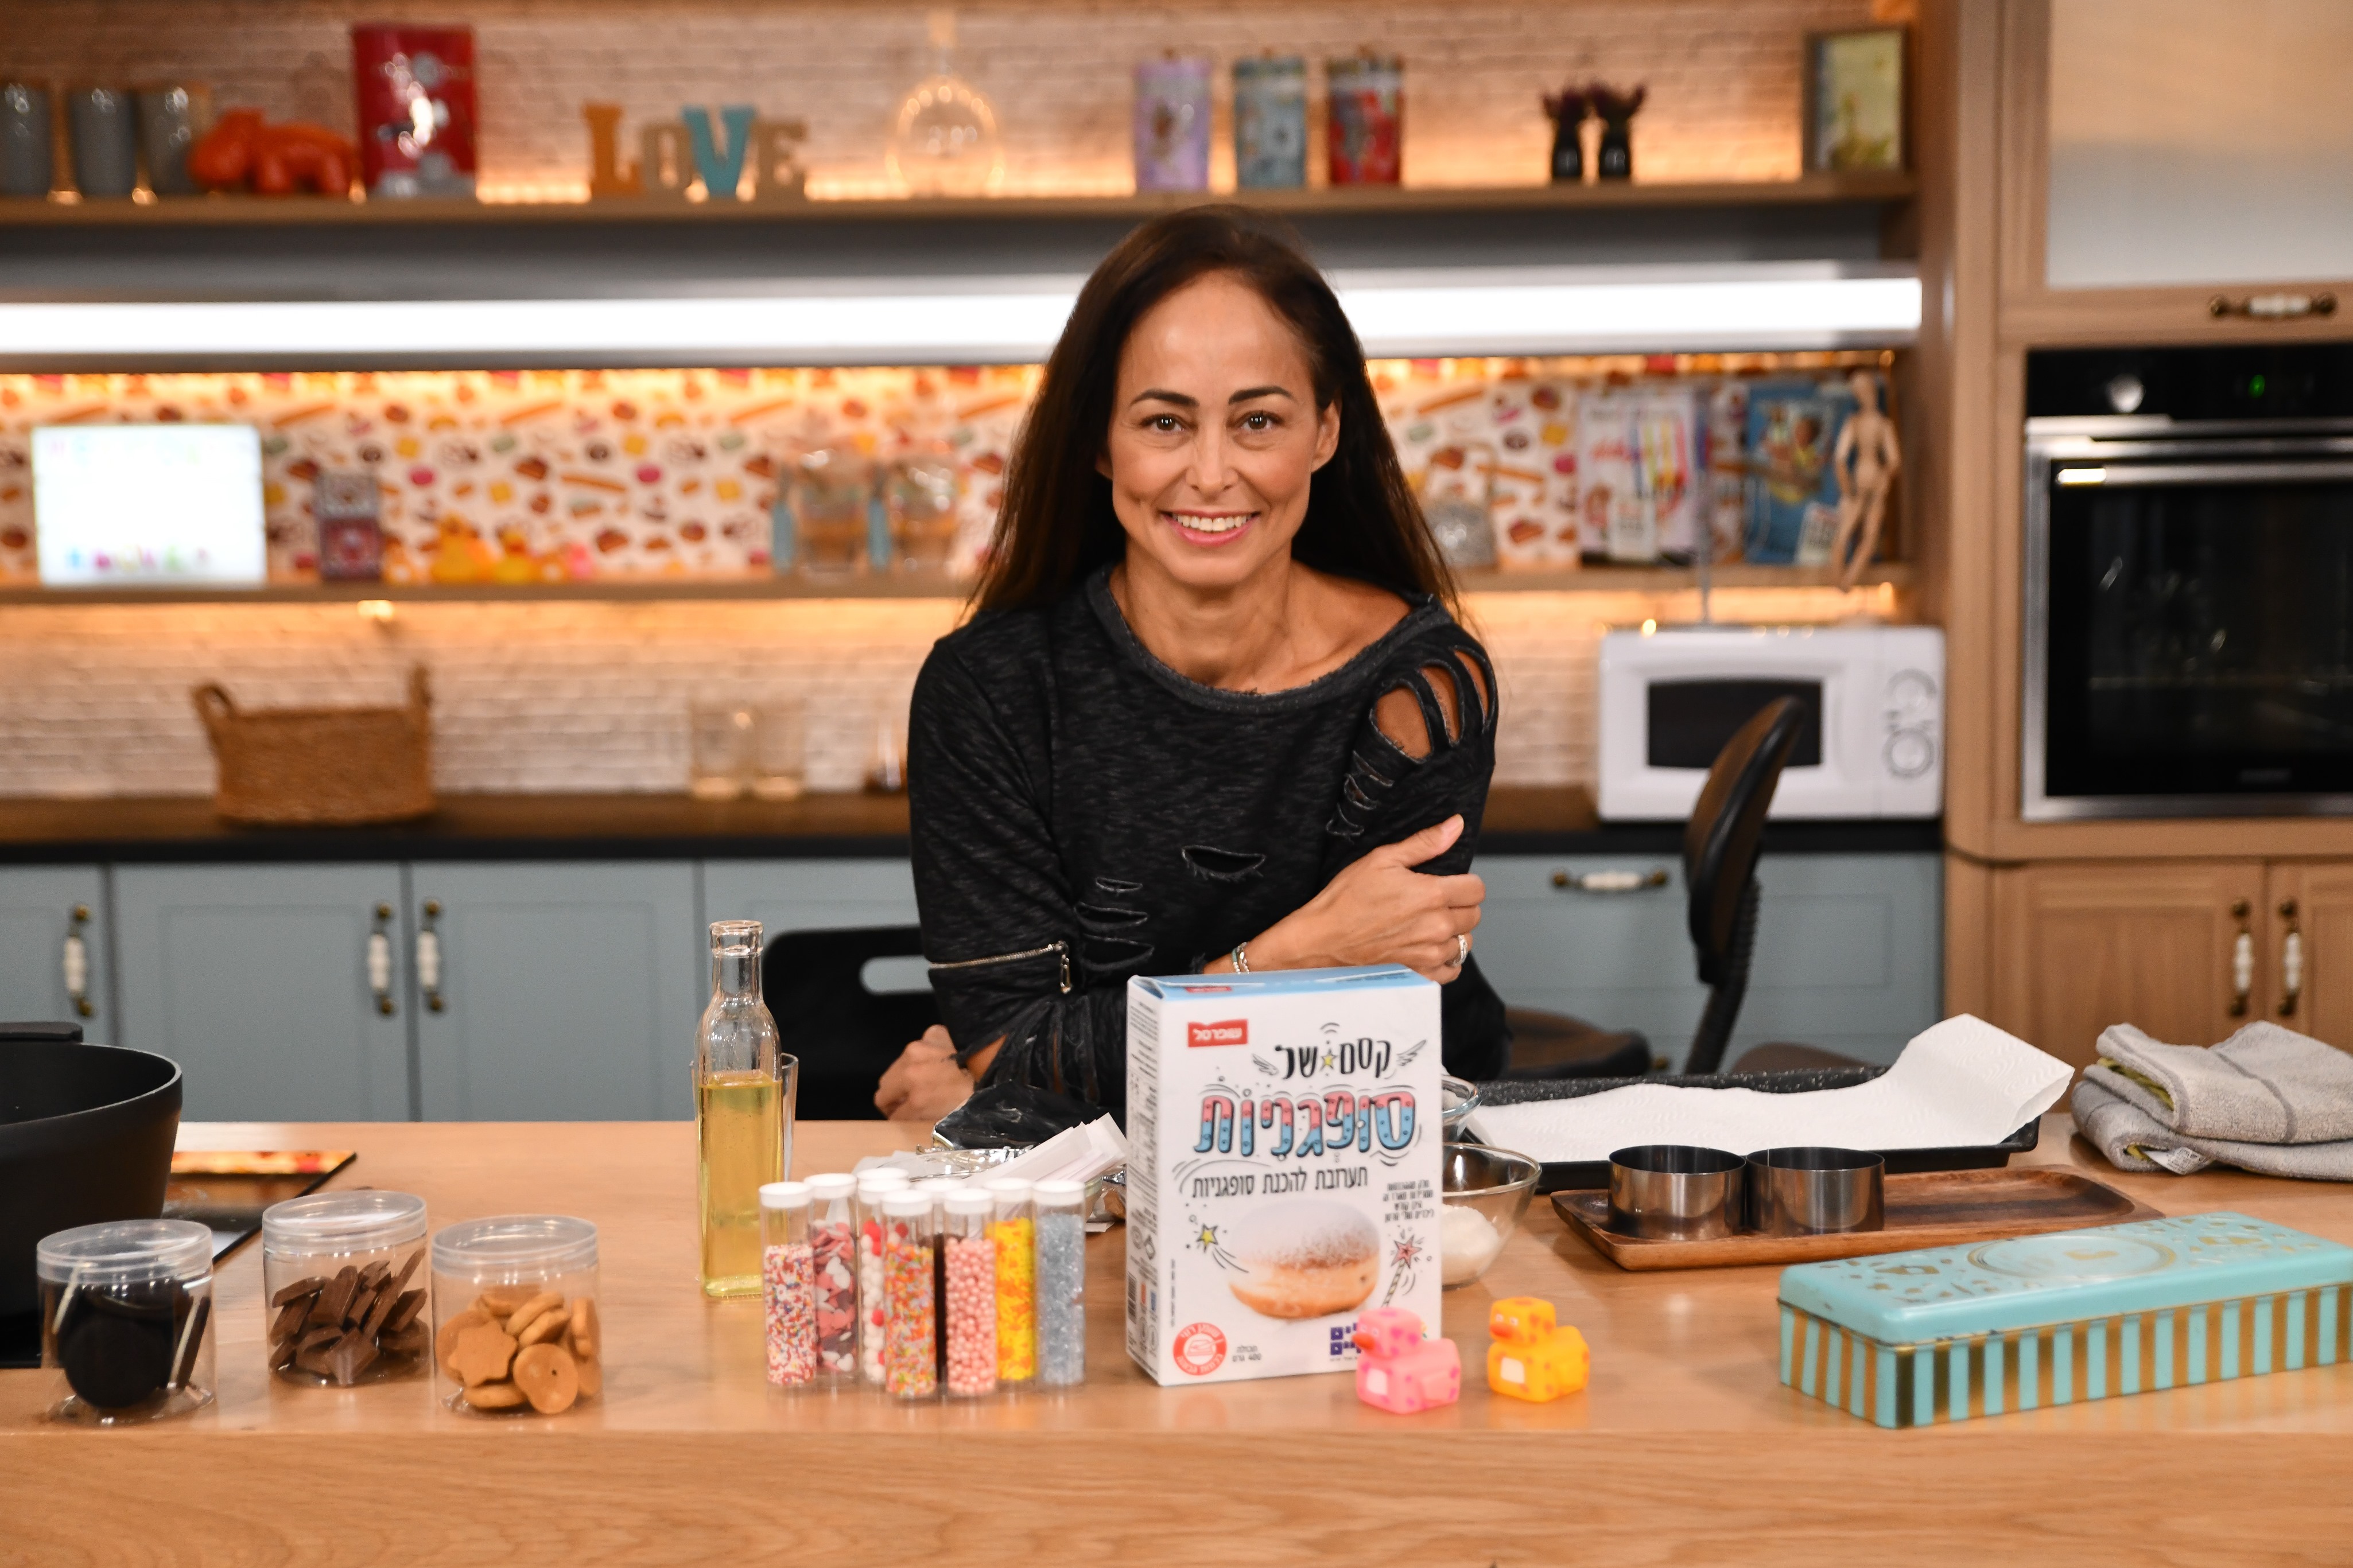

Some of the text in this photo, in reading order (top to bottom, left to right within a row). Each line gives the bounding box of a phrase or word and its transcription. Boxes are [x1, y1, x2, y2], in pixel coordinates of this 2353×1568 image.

[582, 102, 807, 198] LOVE
[1275, 1037, 1391, 1079] קסם של
[1193, 1090, 1416, 1158] סופגניות
[1191, 1174, 1255, 1199] סופגניות
[1263, 1169, 1307, 1195] להכנת
[1315, 1166, 1368, 1190] תערובת
